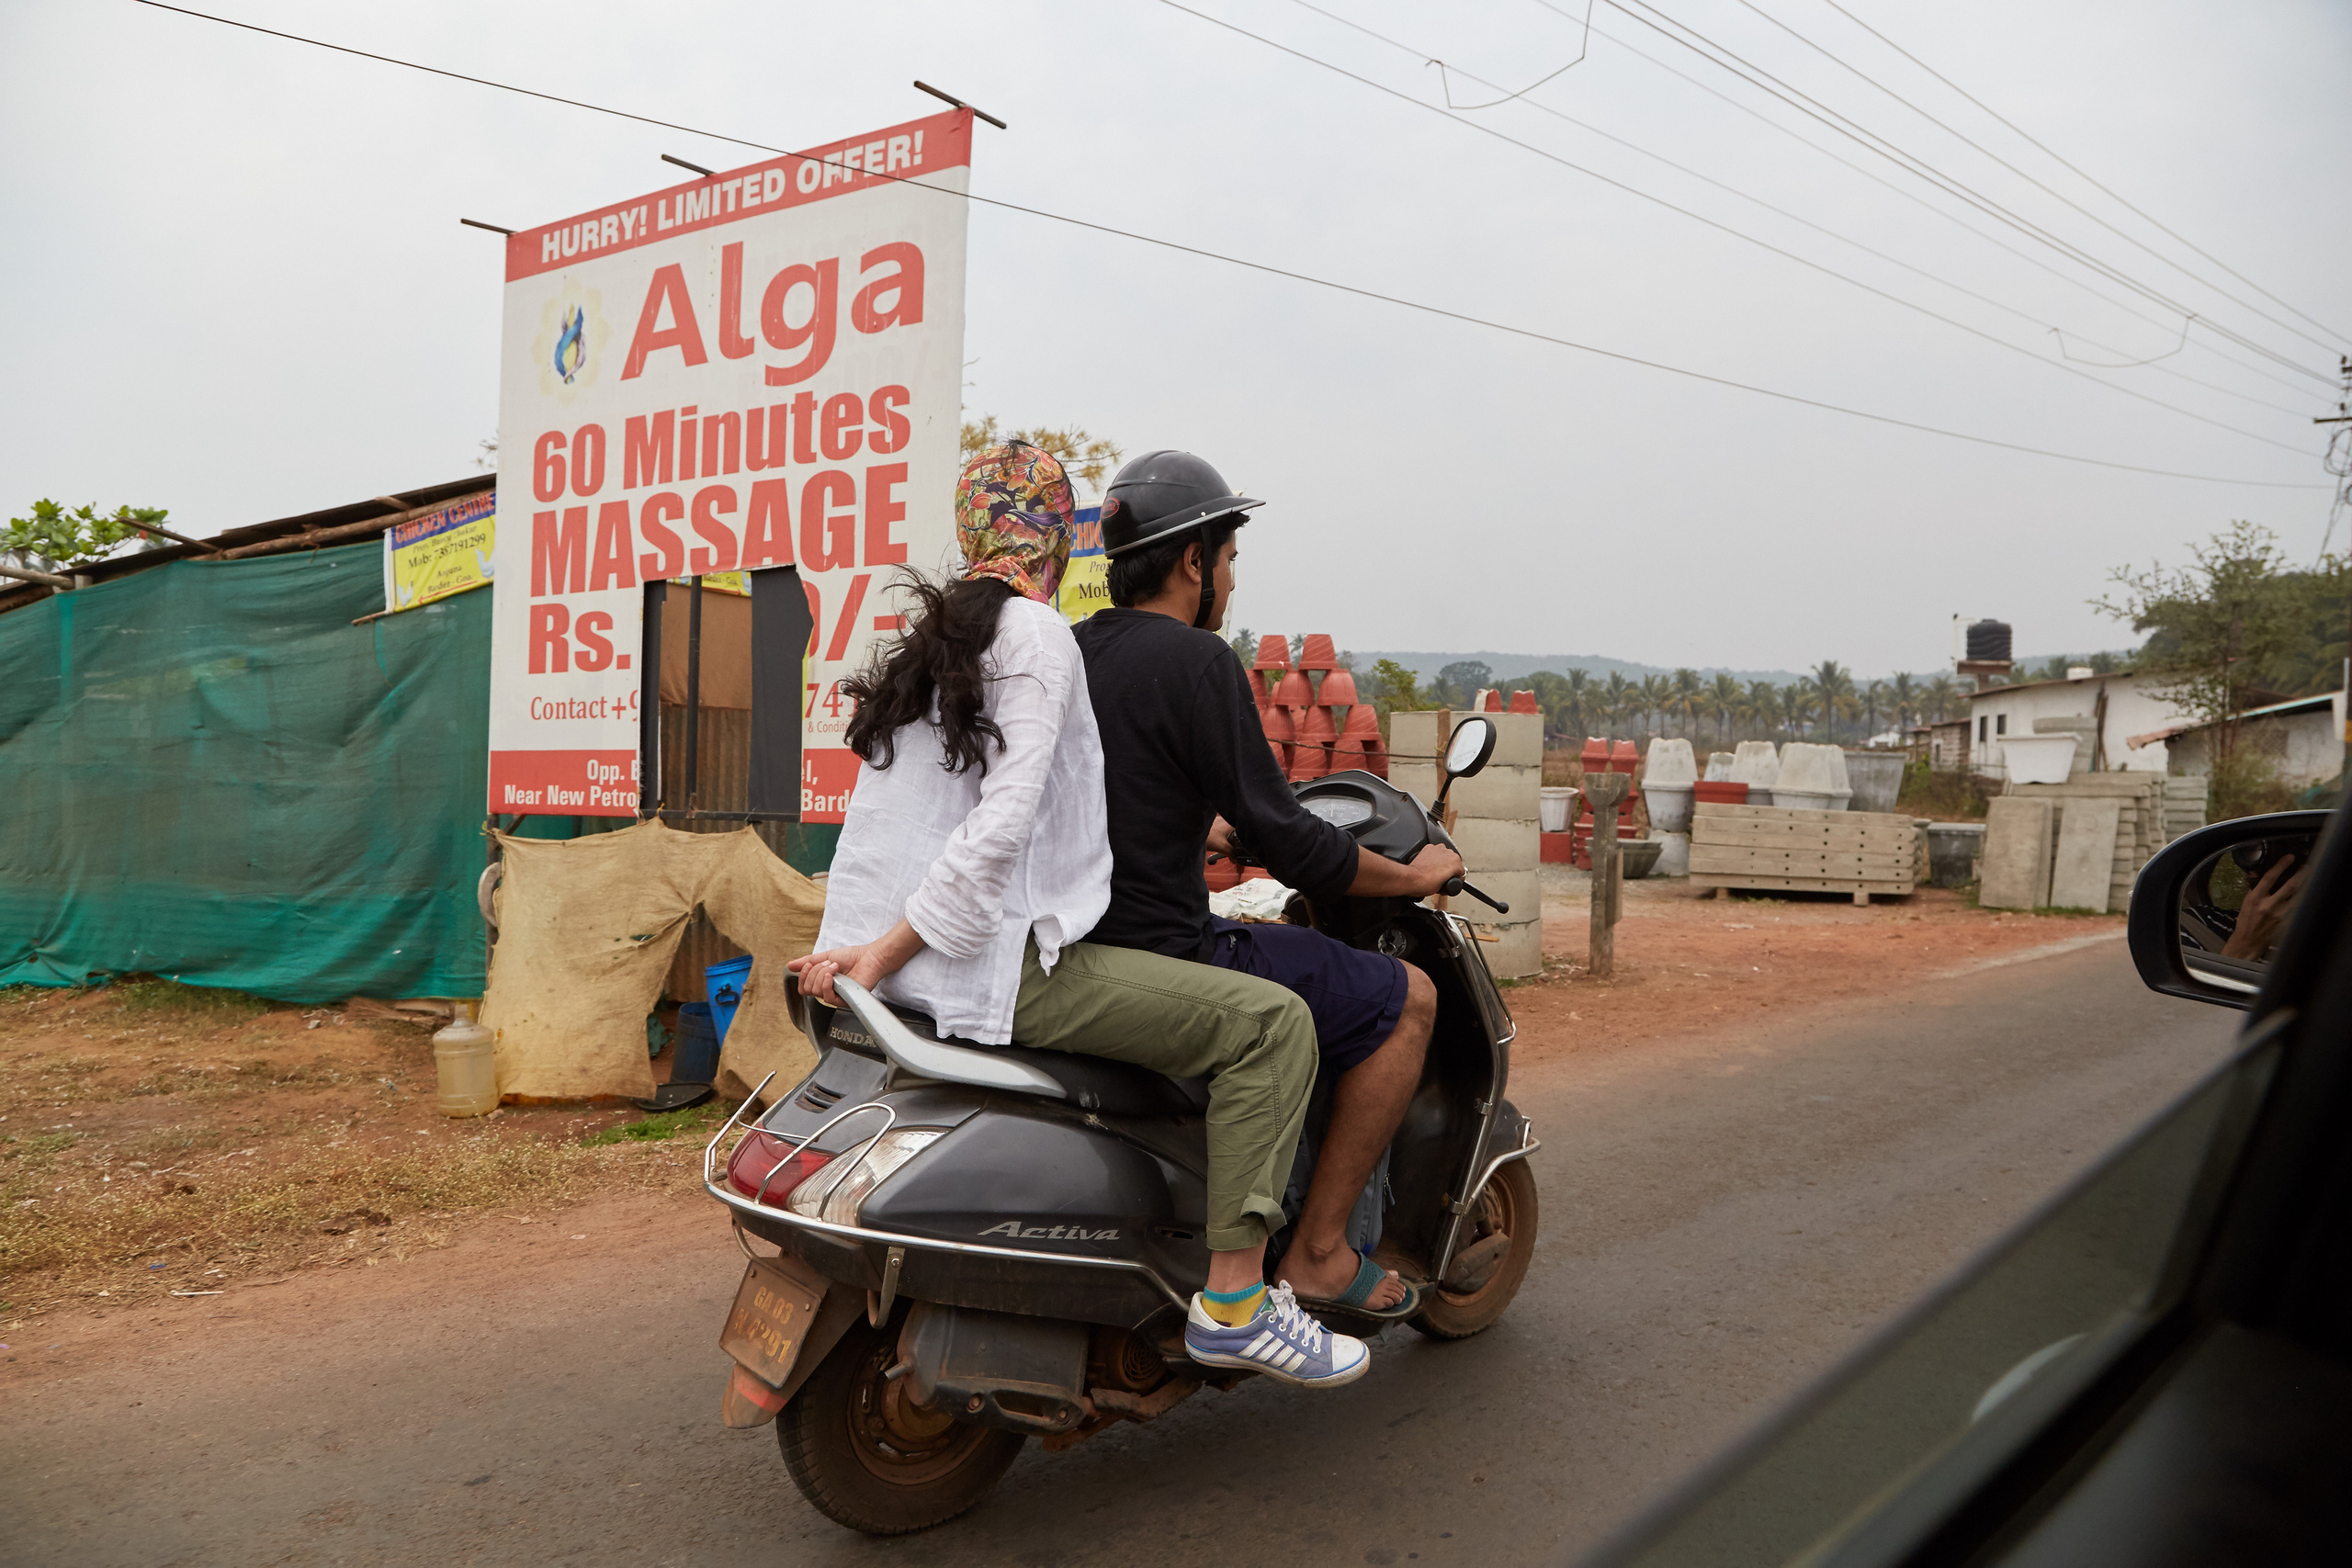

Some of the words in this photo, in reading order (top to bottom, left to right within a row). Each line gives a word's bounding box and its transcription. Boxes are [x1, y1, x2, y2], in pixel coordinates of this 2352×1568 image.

[541, 205, 648, 264] HURRY!
[657, 168, 786, 231] LIMITED
[797, 130, 925, 195] OFFER!
[620, 241, 926, 388] Alga
[533, 423, 606, 503] 60
[623, 383, 911, 491] Minutes
[395, 511, 447, 544] CHICKEN
[529, 462, 909, 598] MASSAGE
[528, 602, 631, 674] Rs.
[530, 695, 608, 721] Contact
[587, 759, 625, 785] Opp.
[504, 784, 542, 806] Near
[547, 785, 585, 806] New
[830, 1026, 877, 1048] HONDA
[977, 1221, 1120, 1241] Activa
[754, 1286, 775, 1314] GA
[772, 1297, 794, 1325] 03
